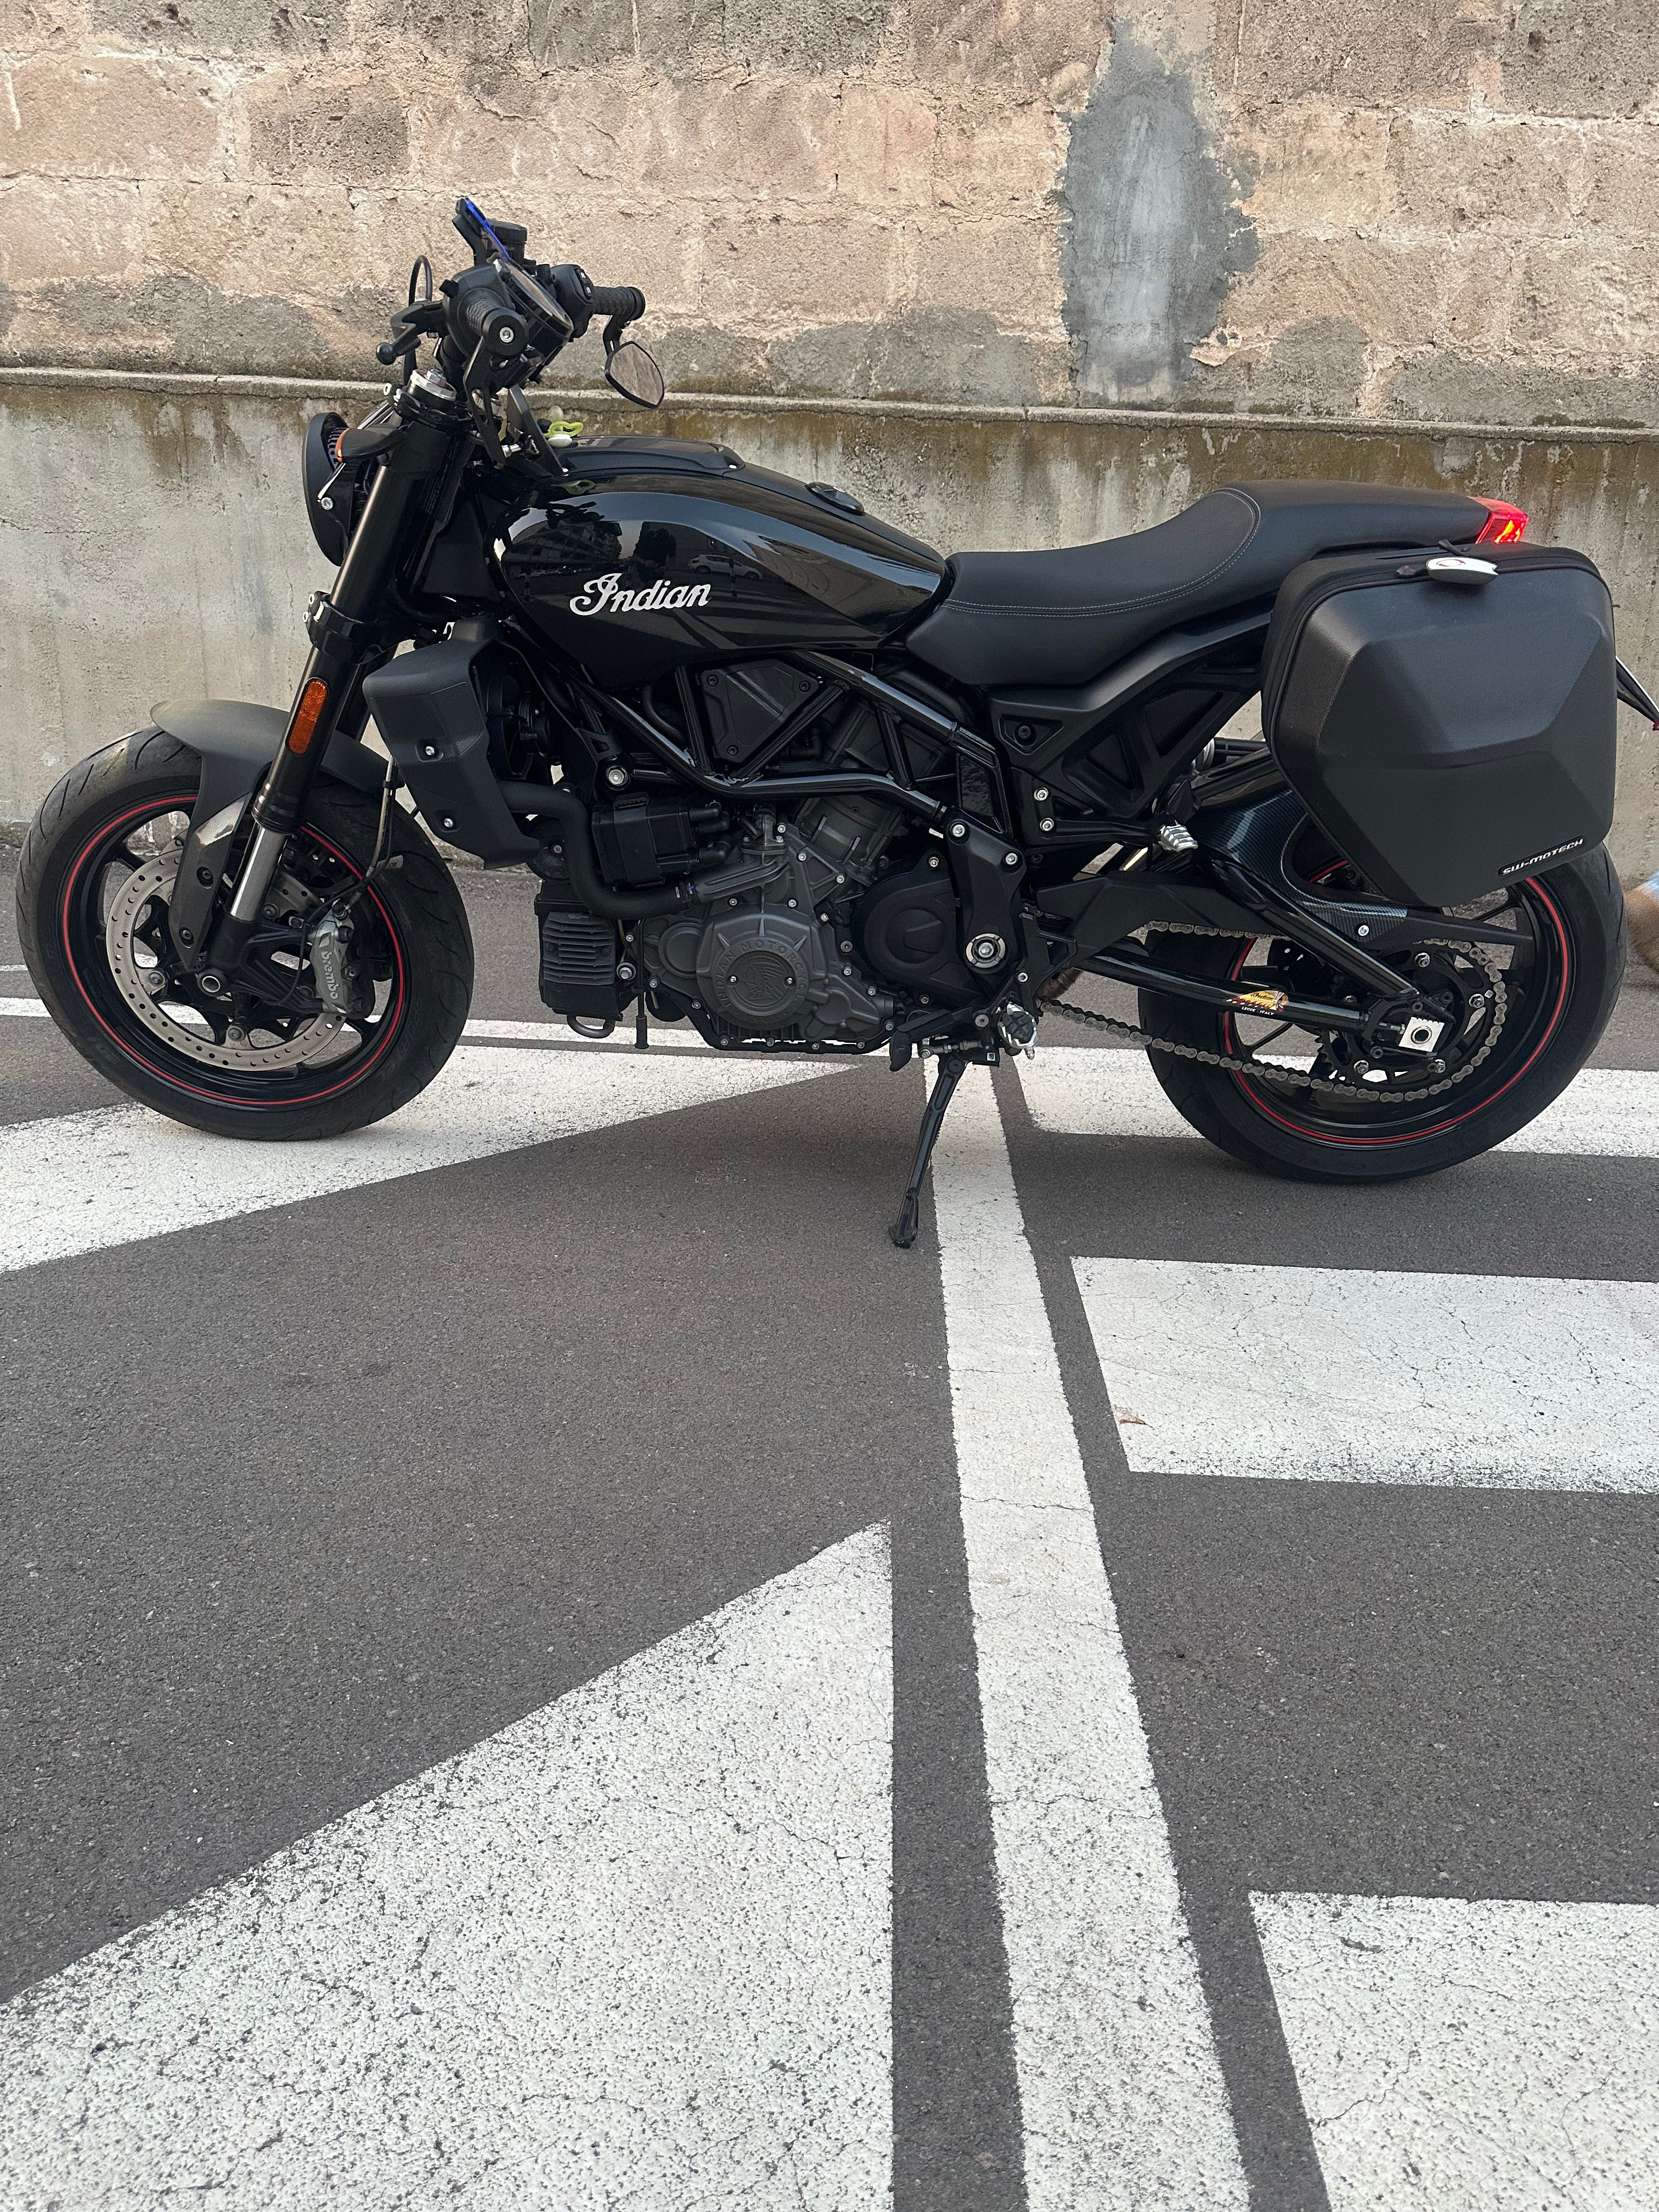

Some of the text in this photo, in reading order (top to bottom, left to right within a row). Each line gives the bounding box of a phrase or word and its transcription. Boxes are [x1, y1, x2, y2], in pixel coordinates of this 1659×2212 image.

[569, 572, 712, 616] Indian
[1502, 838, 1583, 874] SW-MOTECH
[321, 951, 340, 1000] brembo
[715, 951, 737, 1007] INDIAN
